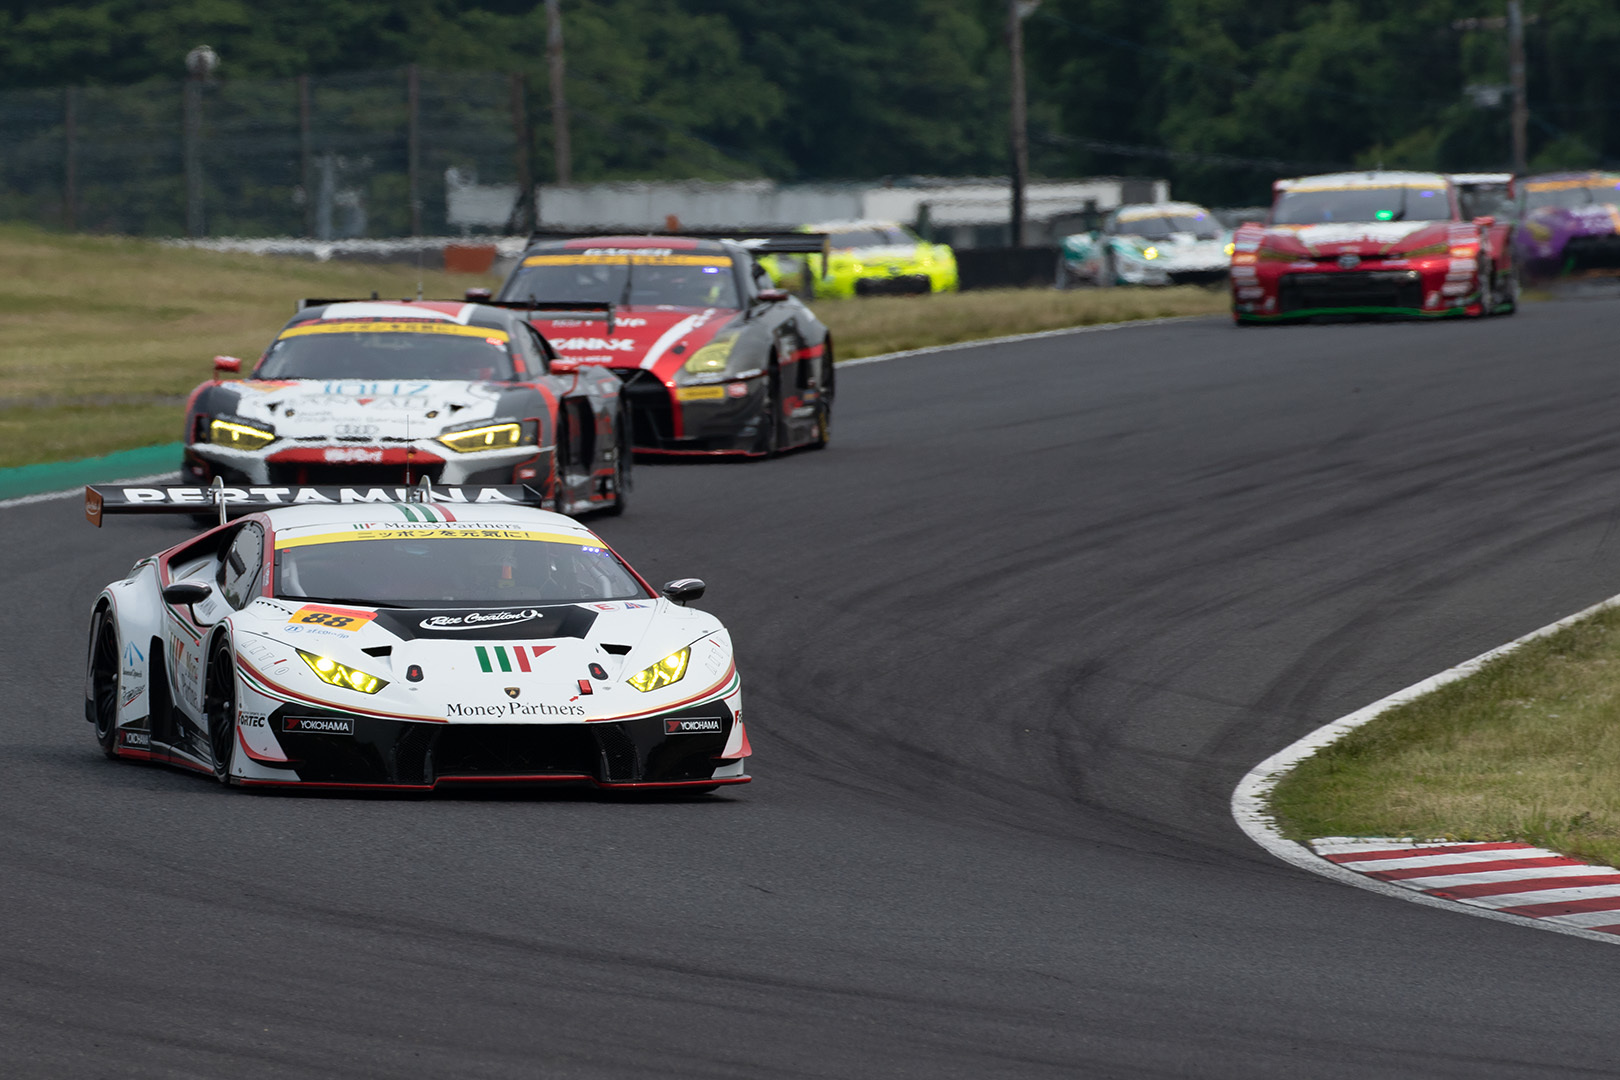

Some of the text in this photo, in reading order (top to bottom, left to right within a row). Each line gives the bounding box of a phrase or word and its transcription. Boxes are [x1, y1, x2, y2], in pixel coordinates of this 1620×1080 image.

[122, 487, 521, 505] PERTAMINA
[301, 613, 354, 628] 88
[447, 702, 585, 717] Money Partners
[300, 720, 350, 731] YOKOHAMA
[680, 721, 719, 730] YOKOHAMA
